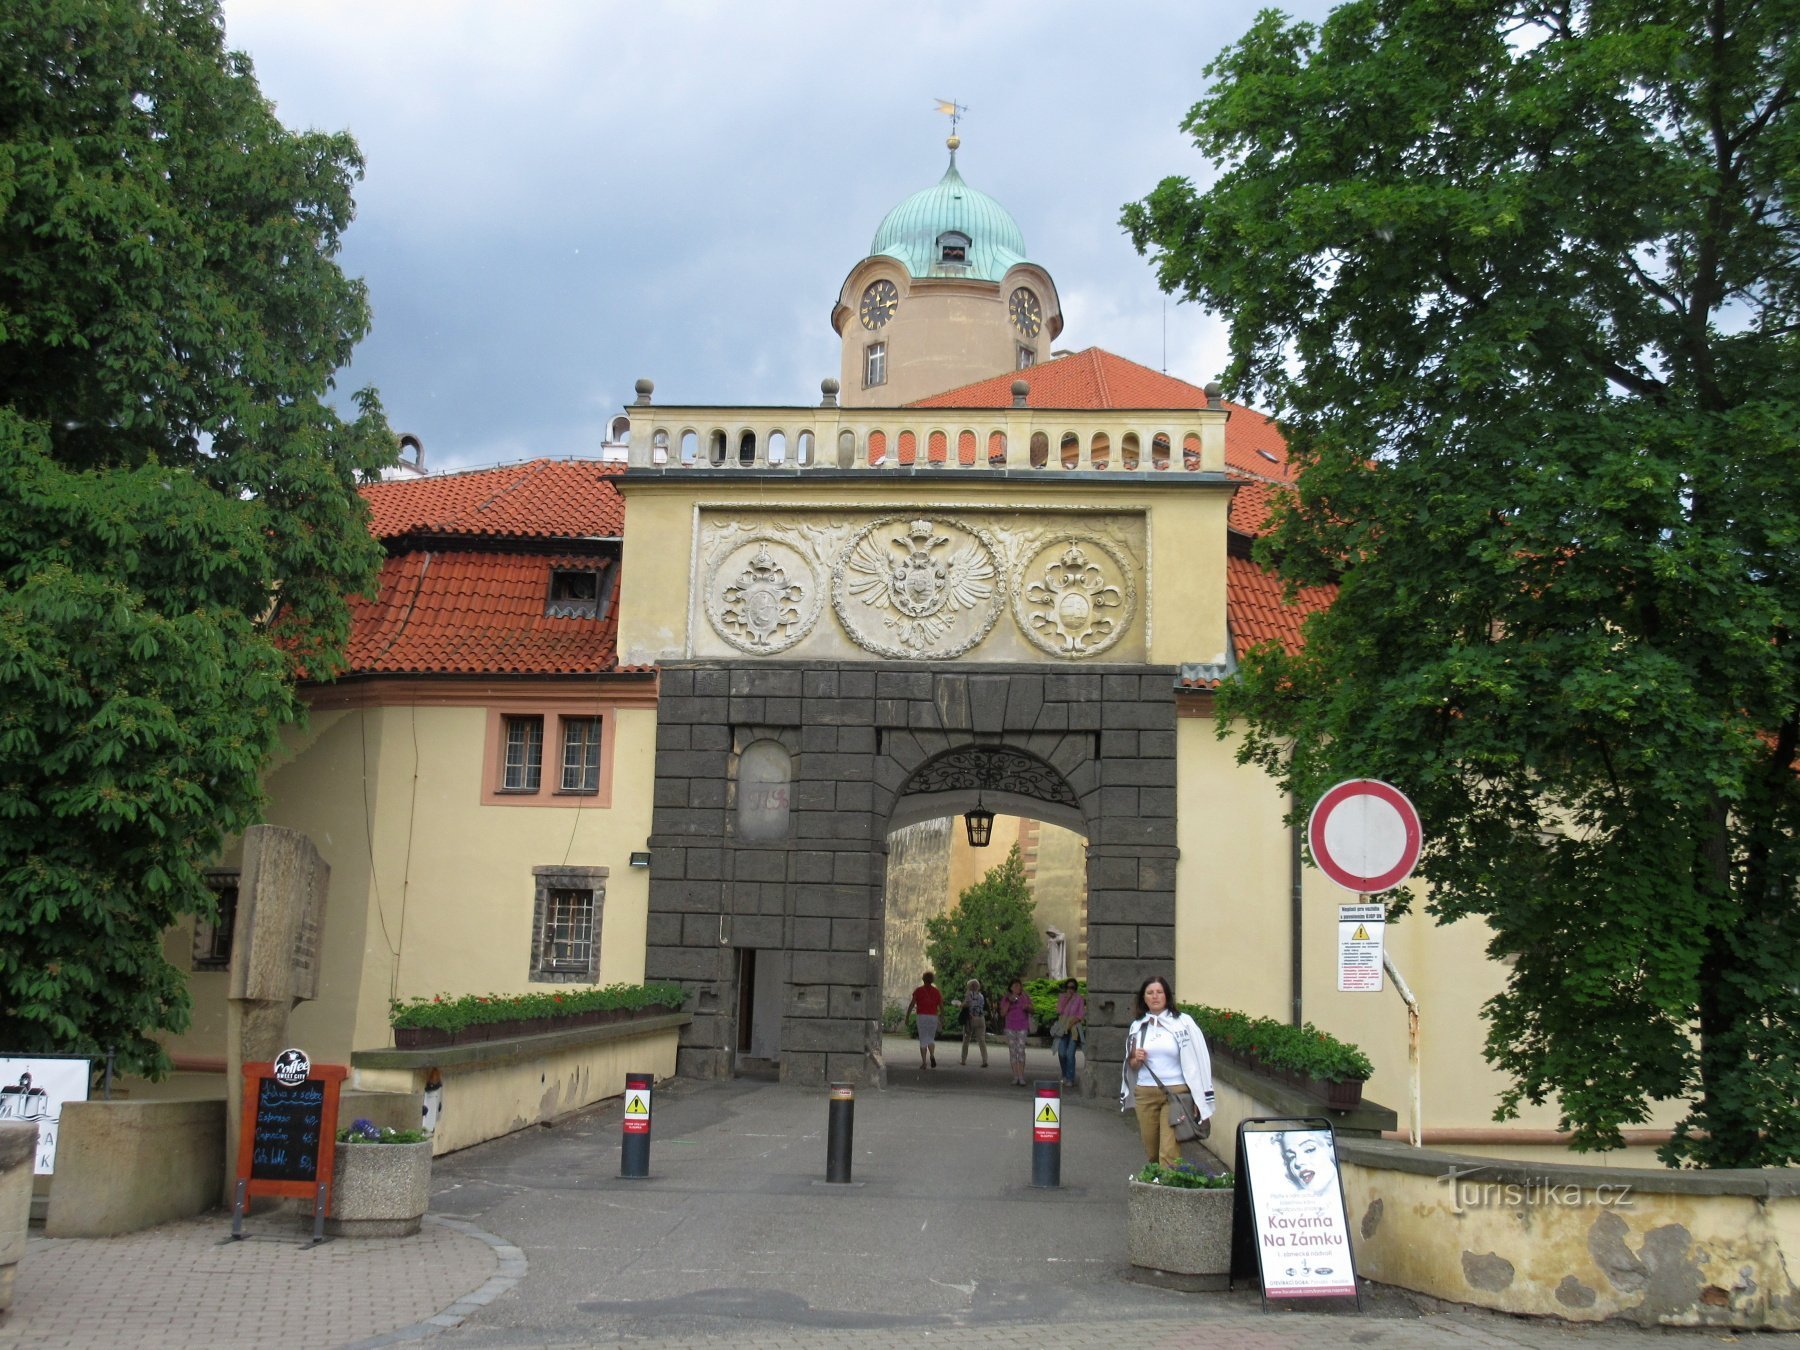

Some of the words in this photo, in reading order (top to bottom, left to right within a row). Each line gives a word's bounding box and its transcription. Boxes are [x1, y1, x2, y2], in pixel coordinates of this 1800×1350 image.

[275, 1059, 308, 1074] Coffee
[1267, 1213, 1333, 1229] Kavárna
[1263, 1233, 1286, 1247] Na
[1289, 1231, 1343, 1247] Zámku
